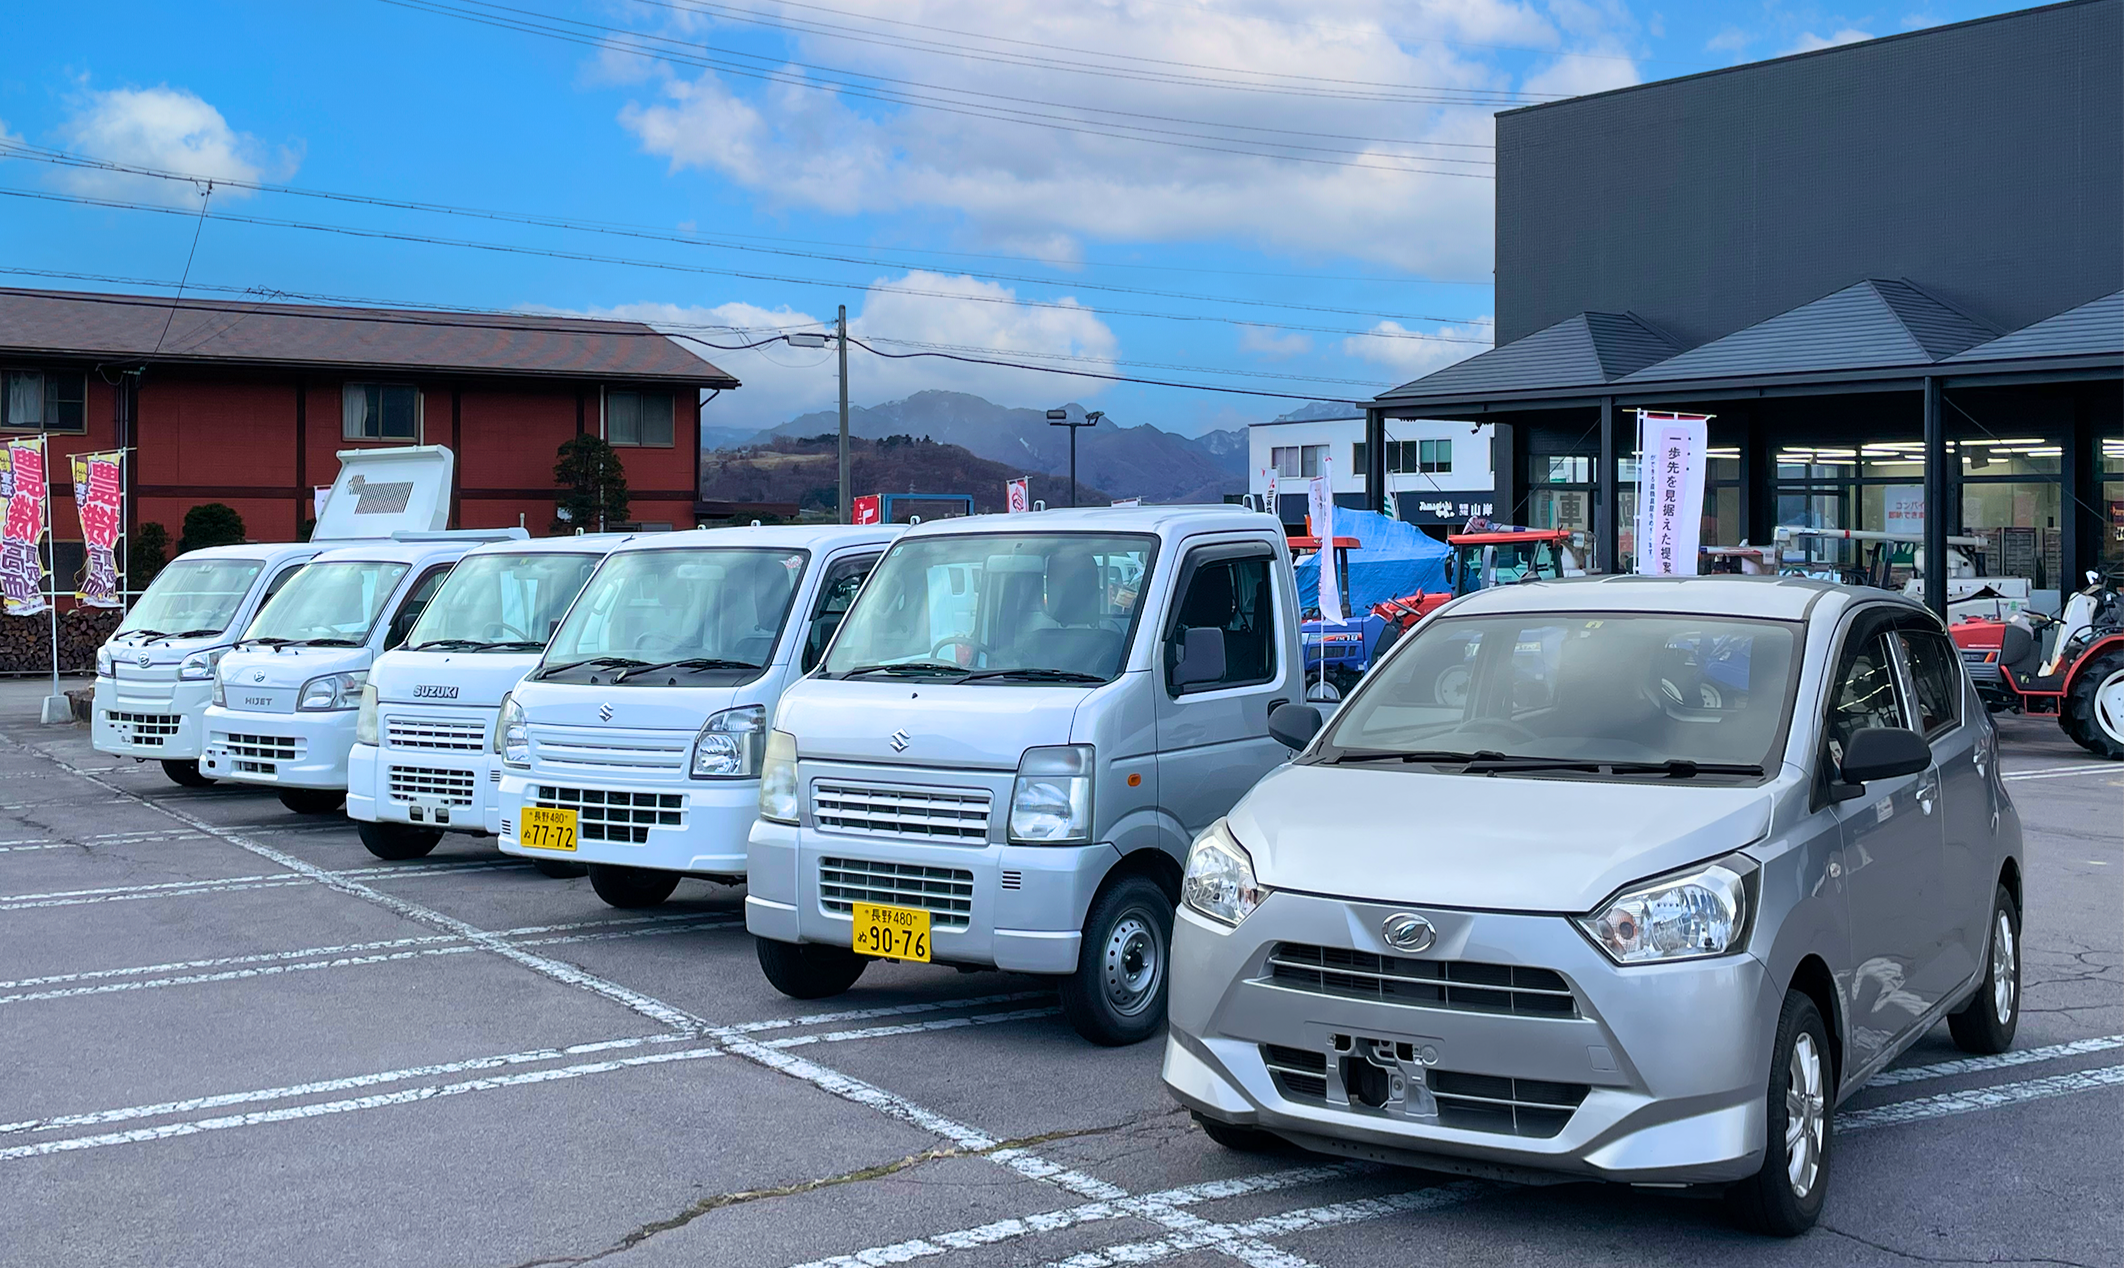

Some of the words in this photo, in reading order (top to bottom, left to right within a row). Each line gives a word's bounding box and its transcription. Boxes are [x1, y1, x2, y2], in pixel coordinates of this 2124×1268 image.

[1559, 493, 1582, 527] 車
[1661, 437, 1682, 574] 一歩先を見据えた提案
[245, 697, 272, 706] HIJET
[413, 685, 459, 699] SUZUKI
[533, 824, 573, 848] 77-72
[872, 908, 912, 926] 長野480
[858, 931, 867, 943] ぬ
[870, 925, 925, 957] 90-76
